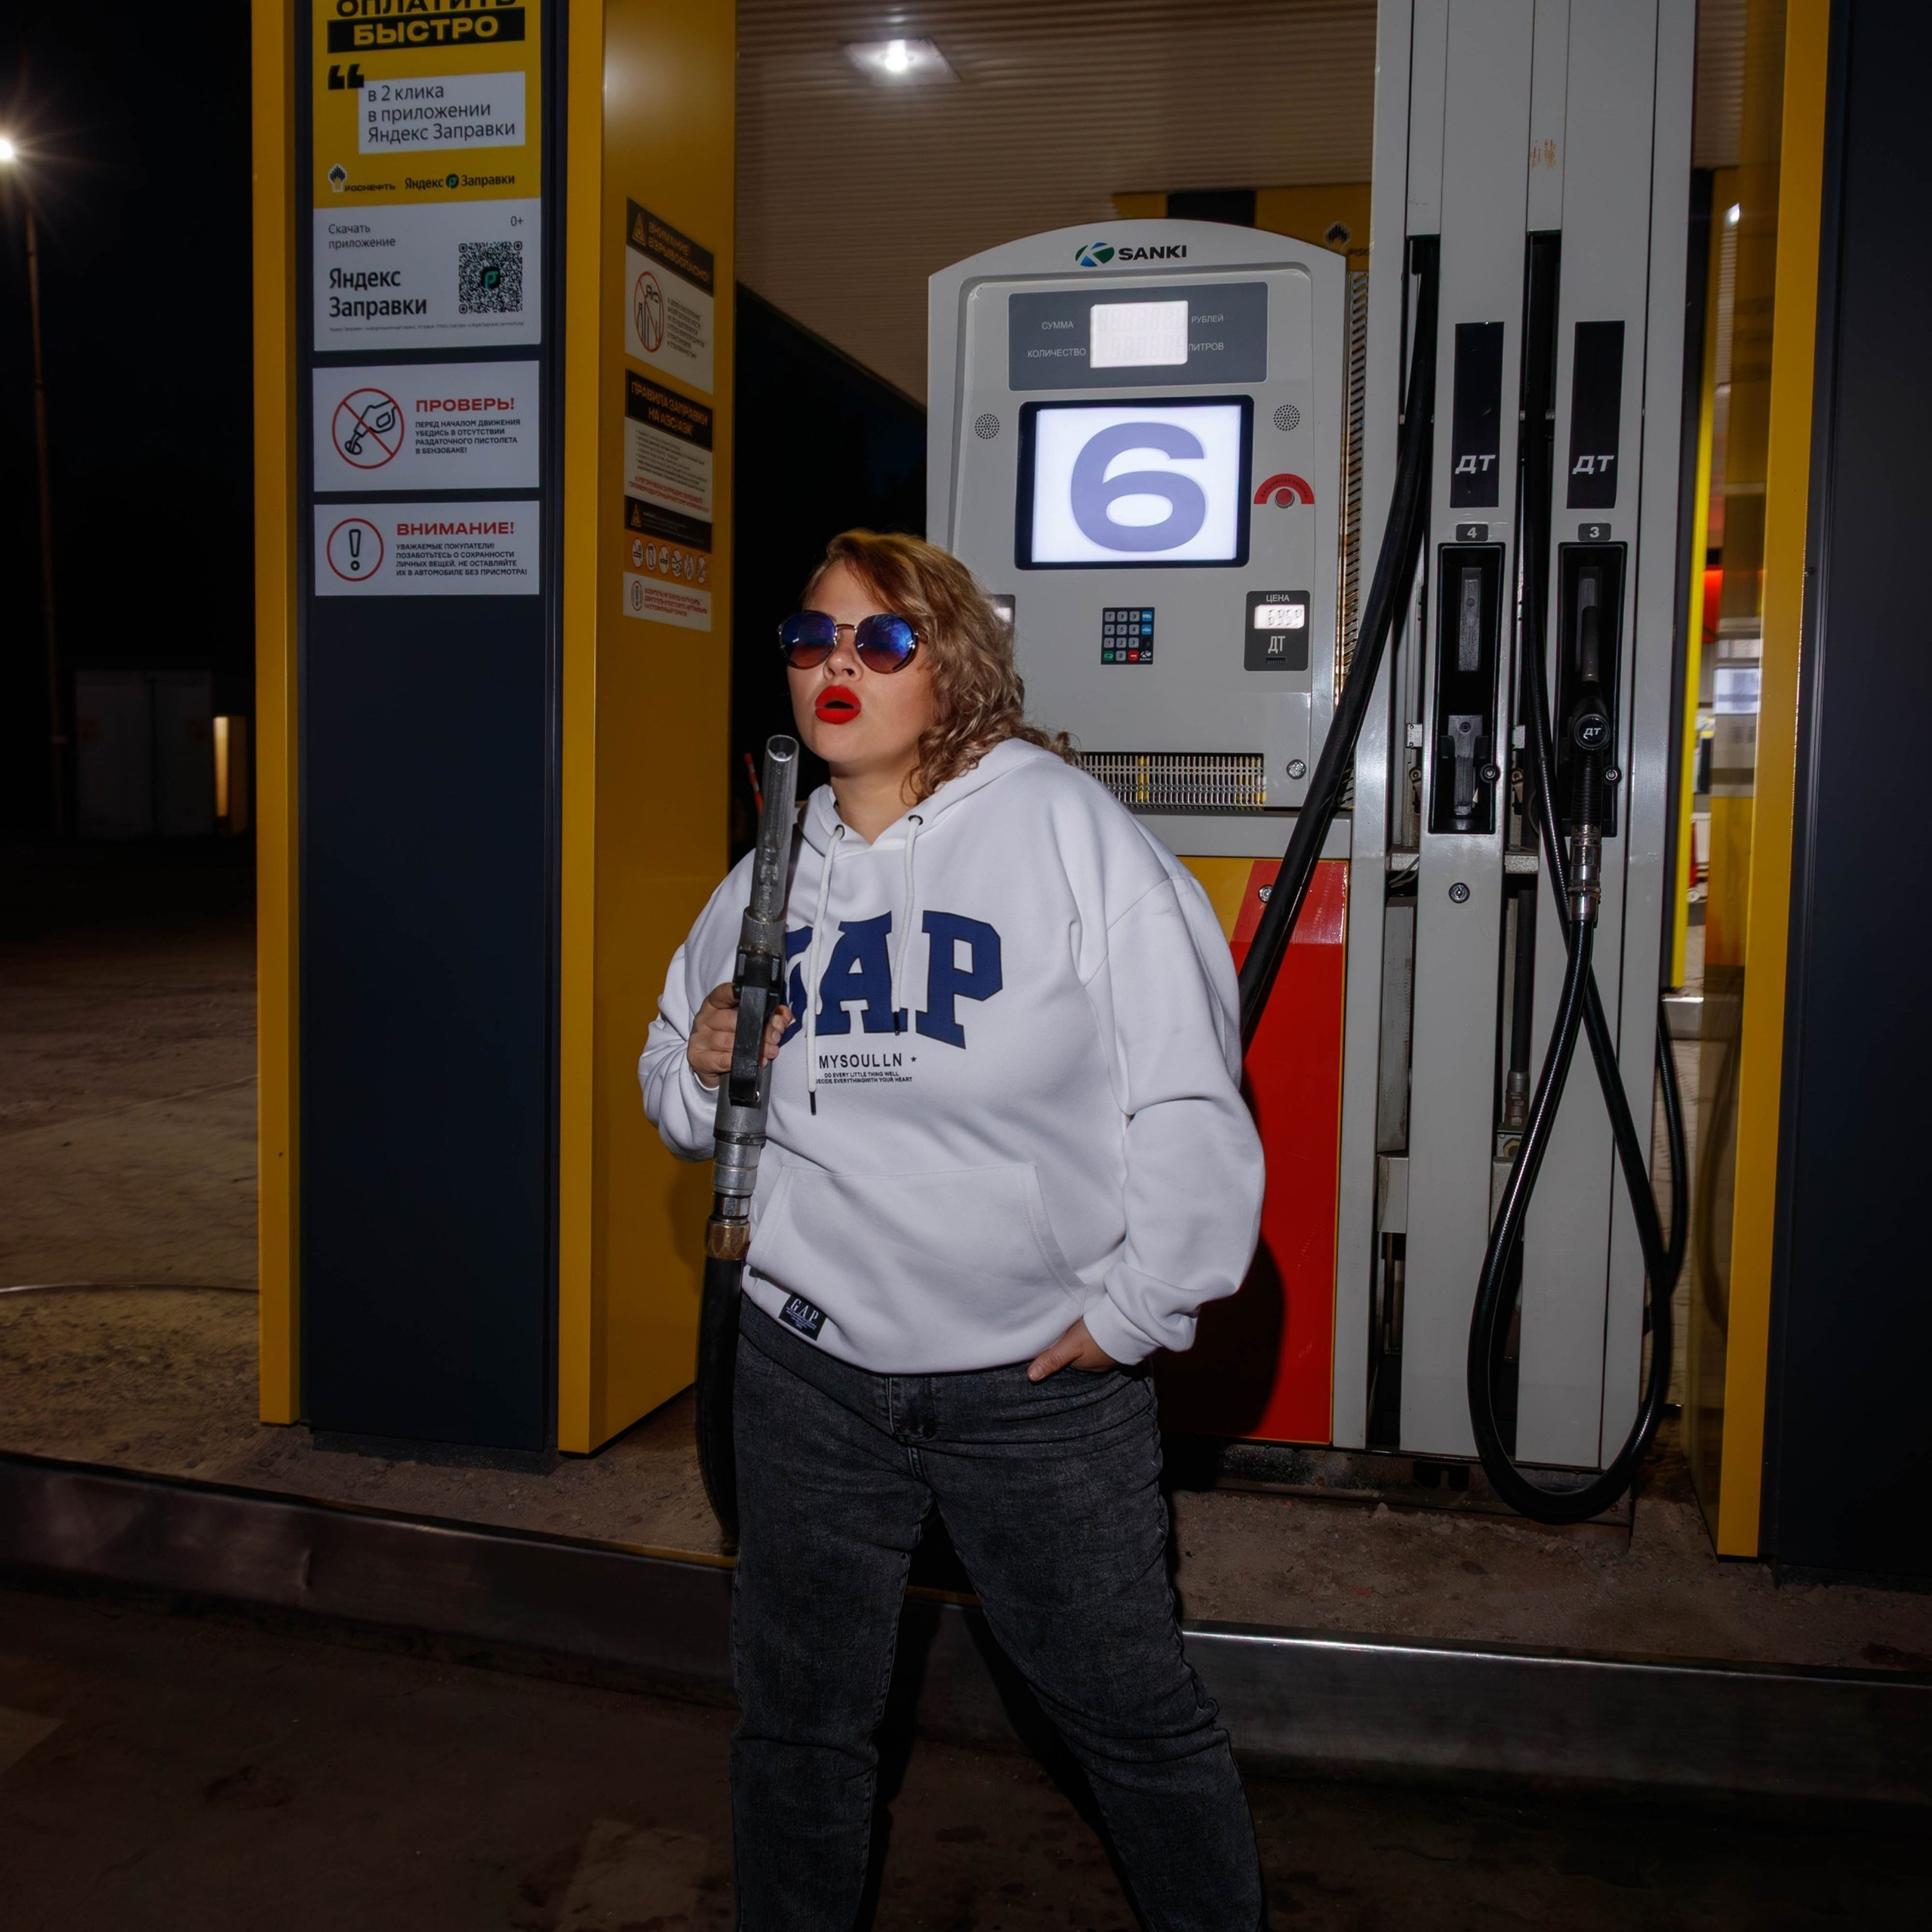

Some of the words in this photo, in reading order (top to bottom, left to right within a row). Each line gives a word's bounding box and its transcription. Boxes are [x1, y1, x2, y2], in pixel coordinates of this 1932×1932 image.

[336, 0, 518, 17] ОПЛА
[353, 15, 499, 46] БЫСТРО
[368, 89, 377, 102] в
[380, 85, 390, 102] 2
[395, 85, 444, 101] клика
[368, 110, 377, 122] в
[381, 103, 491, 124] приложении
[368, 127, 429, 144] Яндекс
[432, 122, 515, 141] Заправки
[344, 183, 396, 192] РОСНЕФТЬ
[405, 176, 445, 190] Яндекс
[461, 174, 515, 189] Заправки
[328, 223, 371, 235] Скачать
[510, 216, 524, 227] 0+
[328, 238, 396, 250] приложение
[1118, 245, 1187, 261] SANKI
[329, 267, 401, 291] Яндекс
[329, 296, 427, 320] Заправки
[1041, 320, 1075, 330] СУММА
[1191, 313, 1224, 324] РУБЛЕЙ
[1027, 348, 1087, 358] КОЛИЧЕСТВО
[1188, 342, 1224, 352] ЛИТРОВ
[416, 397, 515, 412] ПРОВЕРЬ!
[631, 381, 669, 409] ПРАВИЛА
[669, 399, 708, 426] ЗАПРАВКИ
[648, 407, 660, 422] НА
[441, 420, 476, 428] НАЧАЛОМ
[478, 419, 521, 428] ДВИЖЕНИЯ
[415, 429, 449, 438] УБЕДИСЬ
[457, 428, 505, 436] ОТСУТСТВИИ
[415, 438, 473, 446] РАЗДАТОЧНОГО
[474, 436, 518, 445] ПИСТОЛЕТА
[1455, 454, 1496, 475] ДТ
[1572, 454, 1614, 475] ДТ
[1070, 423, 1205, 551] 6
[396, 521, 515, 536] ВНИМАНИЕ!
[1466, 526, 1478, 539] 4
[1589, 526, 1600, 539] 3
[429, 559, 457, 568] ВЕЩЕЙ.
[469, 558, 517, 567] ОСТАВЛЯЙТЕ
[1266, 594, 1290, 603] ЦЕНА
[1267, 635, 1286, 654] ДТ
[1583, 728, 1602, 737] ДТ
[819, 1053, 903, 1069] MYSOULLN
[790, 1298, 819, 1321] GAP
